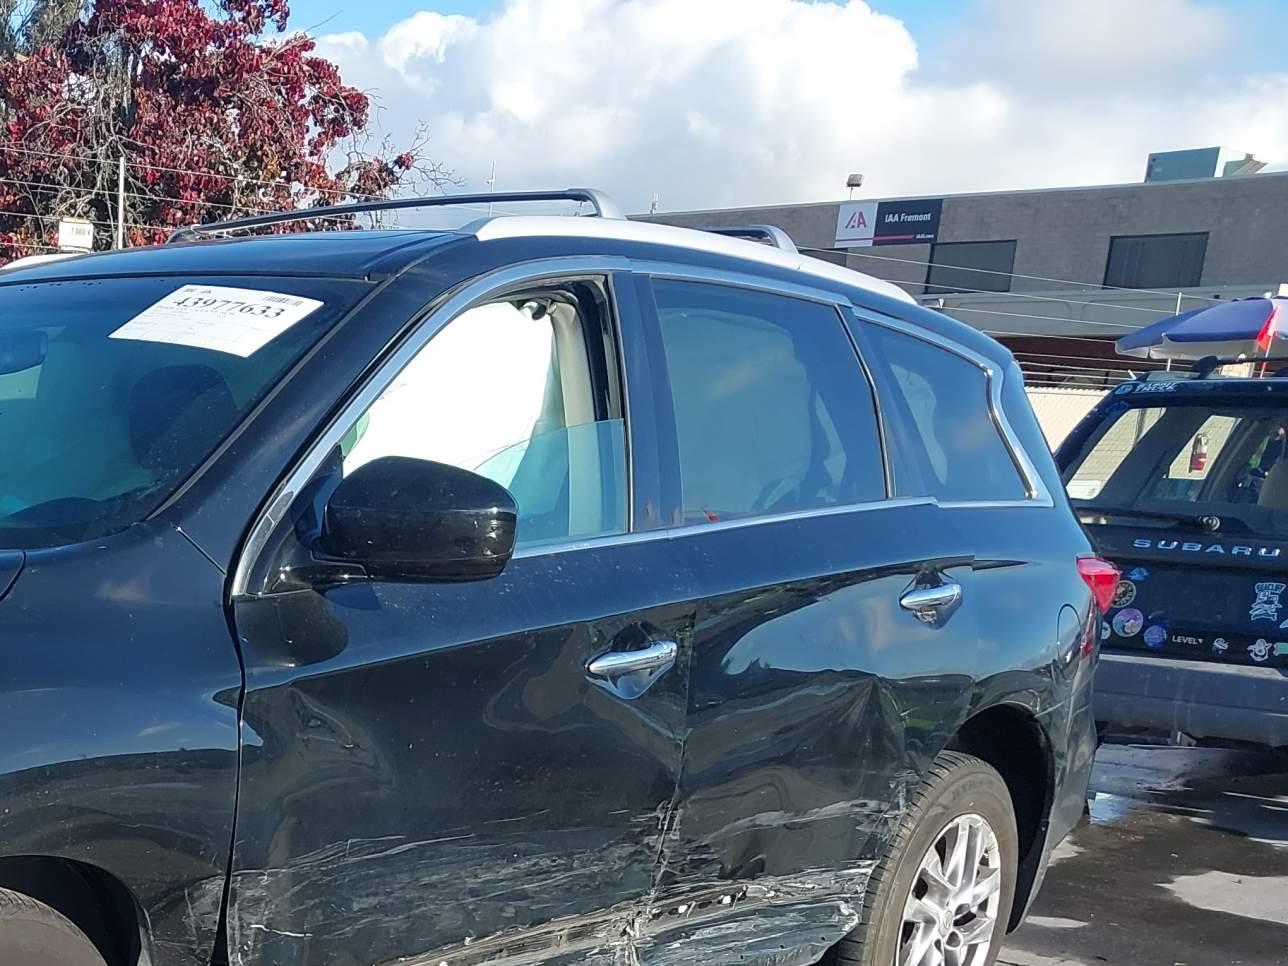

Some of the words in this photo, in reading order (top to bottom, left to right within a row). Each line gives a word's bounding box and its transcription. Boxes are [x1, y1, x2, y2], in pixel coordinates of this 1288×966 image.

[885, 213, 899, 223] IAA
[901, 212, 932, 222] Fremont
[174, 297, 286, 319] 43977633
[1133, 539, 1281, 557] SUBARU
